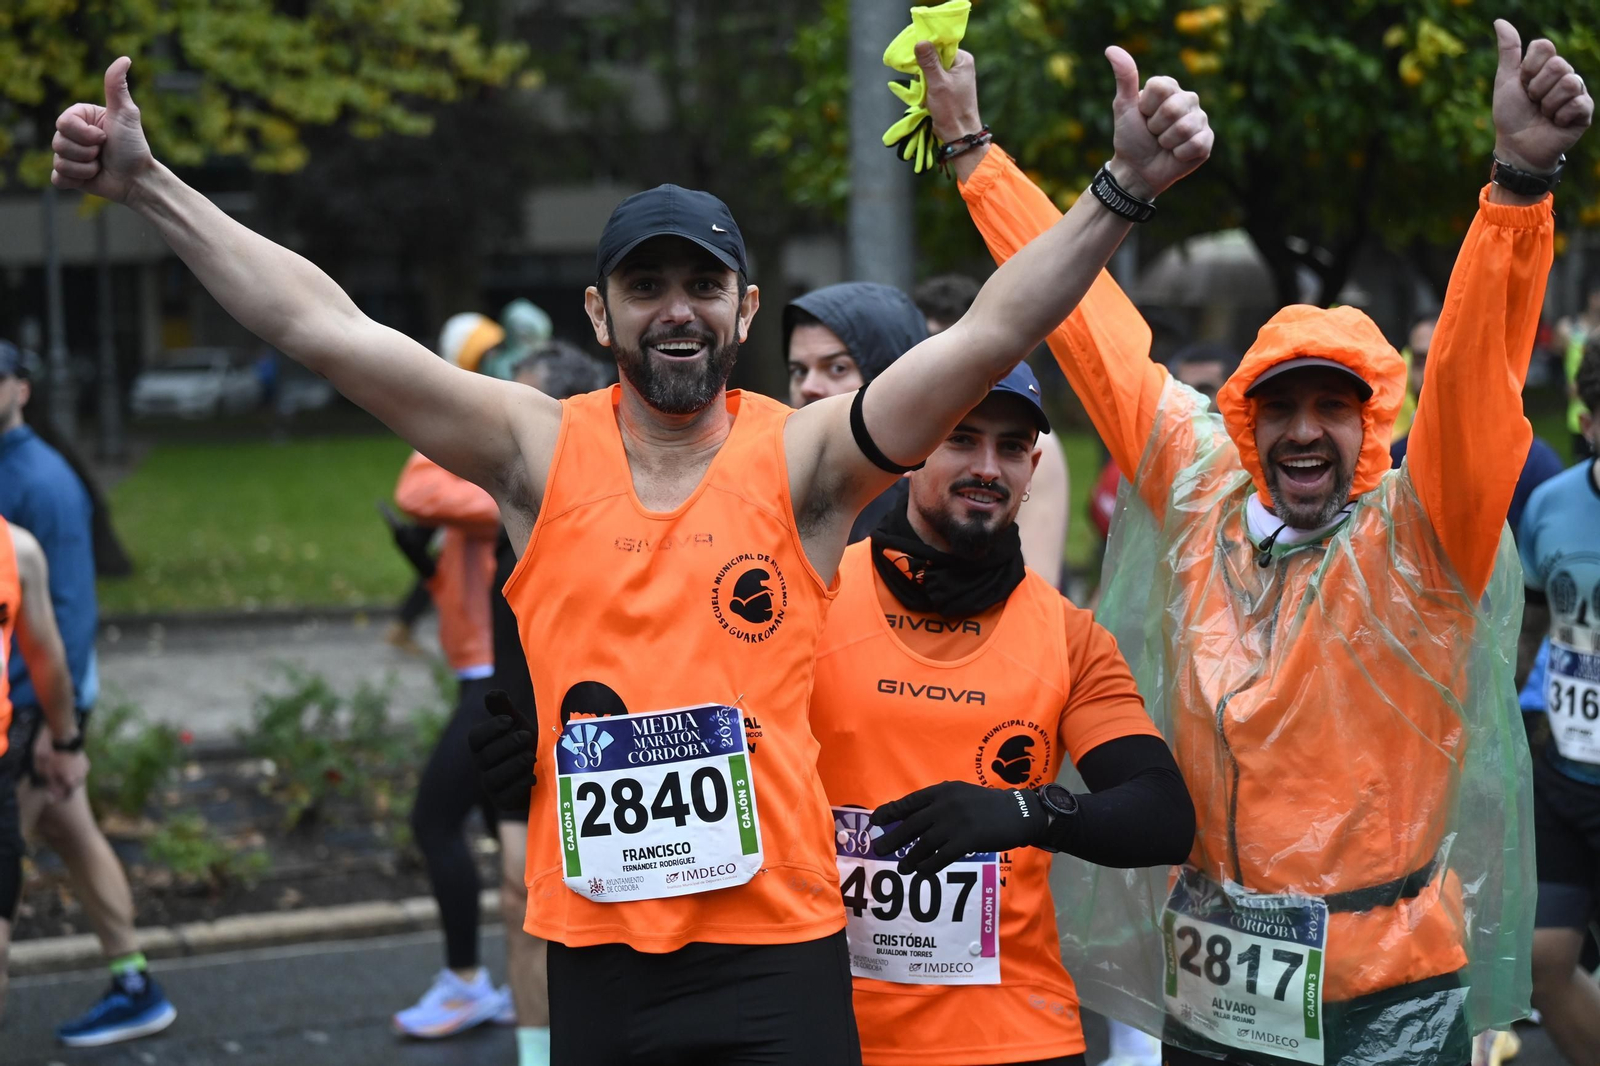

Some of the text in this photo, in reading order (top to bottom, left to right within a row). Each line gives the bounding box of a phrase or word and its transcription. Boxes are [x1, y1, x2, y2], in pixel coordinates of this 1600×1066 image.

[711, 554, 788, 630] ESCUELA MUNICIPAL DE ATLETISMO
[728, 609, 785, 644] GUARROMAN
[885, 614, 981, 636] GIVOVA
[877, 679, 986, 706] GIVOVA
[631, 712, 698, 737] MEDIA
[717, 707, 734, 748] 2025
[633, 729, 702, 750] MARATÓN
[975, 745, 988, 786] ESCUELA
[982, 719, 1026, 744] MUNICIPAL
[1027, 721, 1040, 732] DE
[1039, 729, 1051, 774] ATLETISMO
[574, 741, 602, 769] 39
[627, 742, 711, 764] CÓRDOBA
[576, 766, 729, 838] 2840
[736, 779, 752, 829] CAJÓN 3
[1012, 790, 1030, 818] KIPRUN
[567, 811, 576, 851] CAJÓN
[622, 841, 692, 862] FRANCISCO
[622, 856, 696, 872] FERNÁNDEZ RODRÍGUEZ
[606, 876, 645, 886] AYUNTAMIENTO
[681, 862, 737, 882] IMDECO
[840, 866, 978, 923] 4907
[984, 895, 993, 934] CAJÓN
[872, 932, 937, 949] CRISTÓBAL
[876, 948, 933, 958] BUJALDON TORRES
[924, 962, 974, 973] IMDECO
[1176, 925, 1304, 1002] 2817
[1212, 996, 1256, 1017] ALVARO
[1308, 983, 1316, 1018] CAJÓN
[1212, 1010, 1231, 1020] VILLAR
[1251, 1030, 1299, 1049] IMDECO
